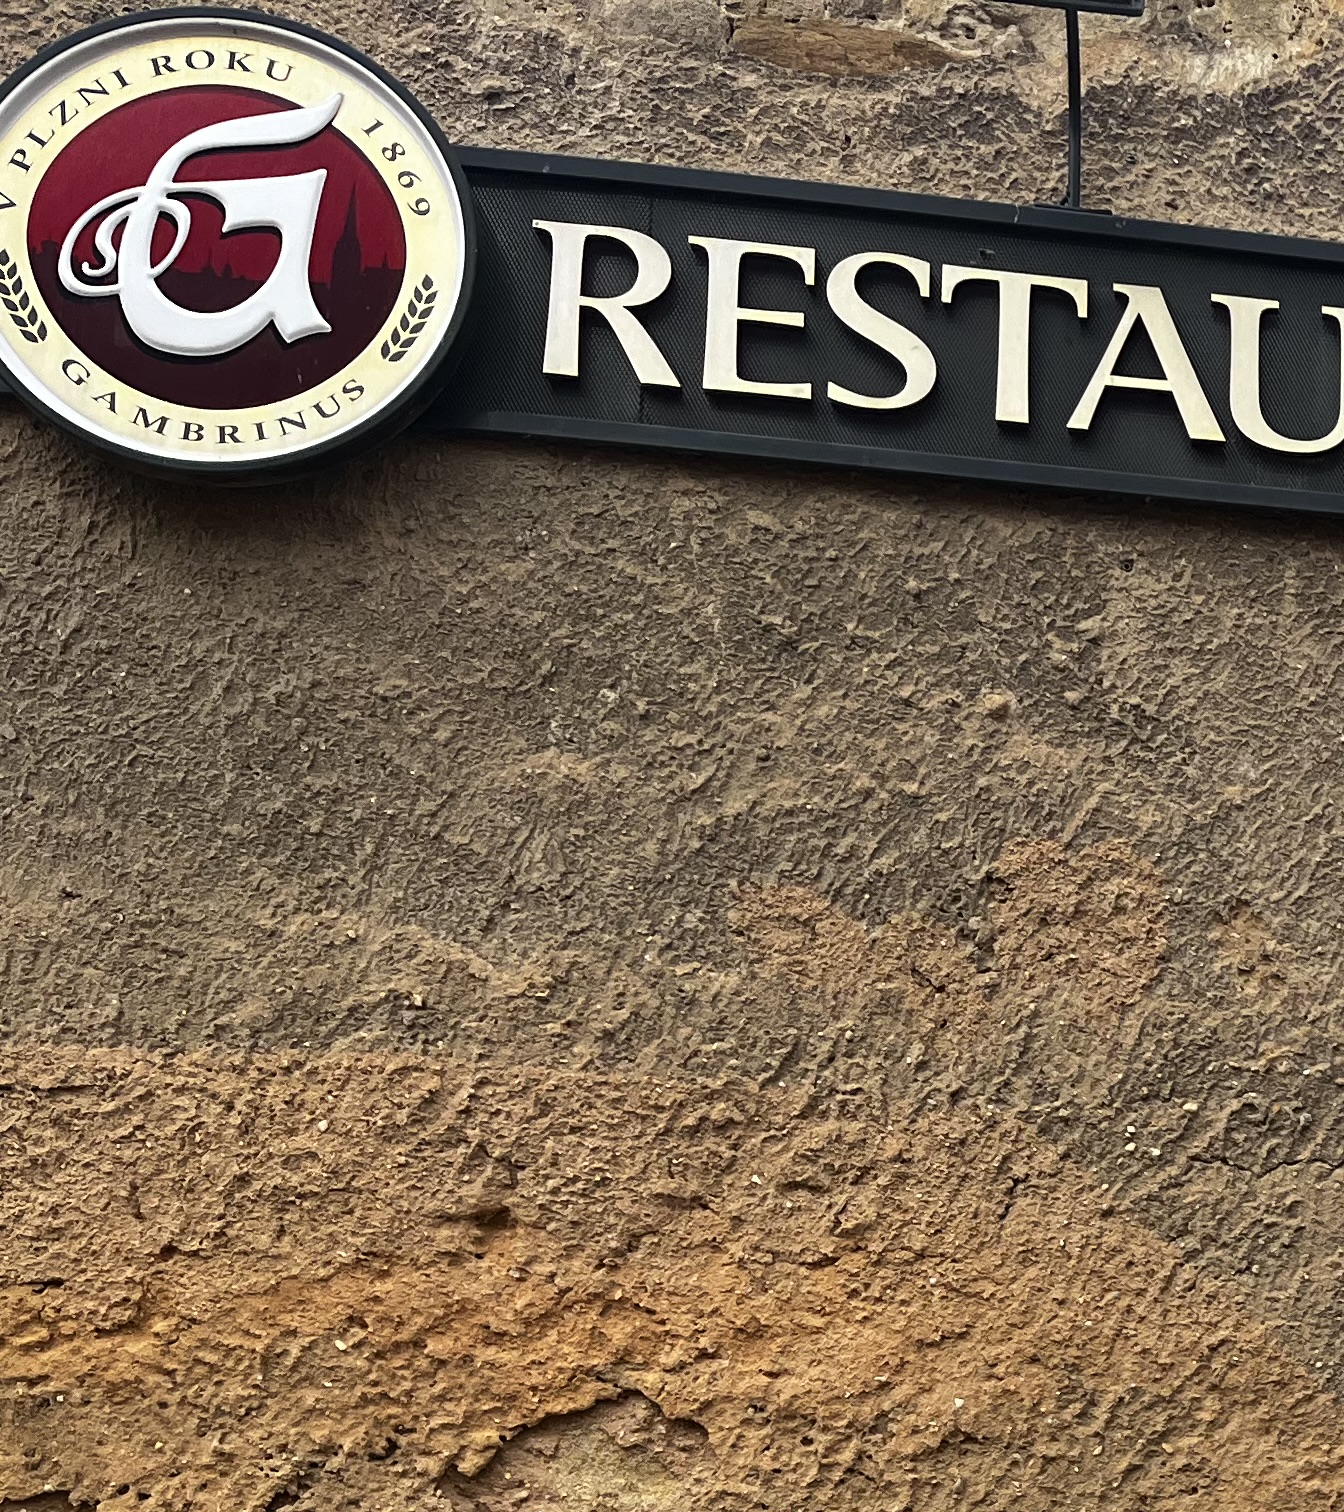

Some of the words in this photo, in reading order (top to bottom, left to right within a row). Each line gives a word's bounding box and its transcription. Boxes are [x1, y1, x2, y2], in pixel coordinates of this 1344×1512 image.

[8, 68, 132, 174] PLZNI
[149, 48, 295, 84] ROKU
[360, 117, 432, 218] 1869
[60, 358, 366, 445] GAMBRINUS
